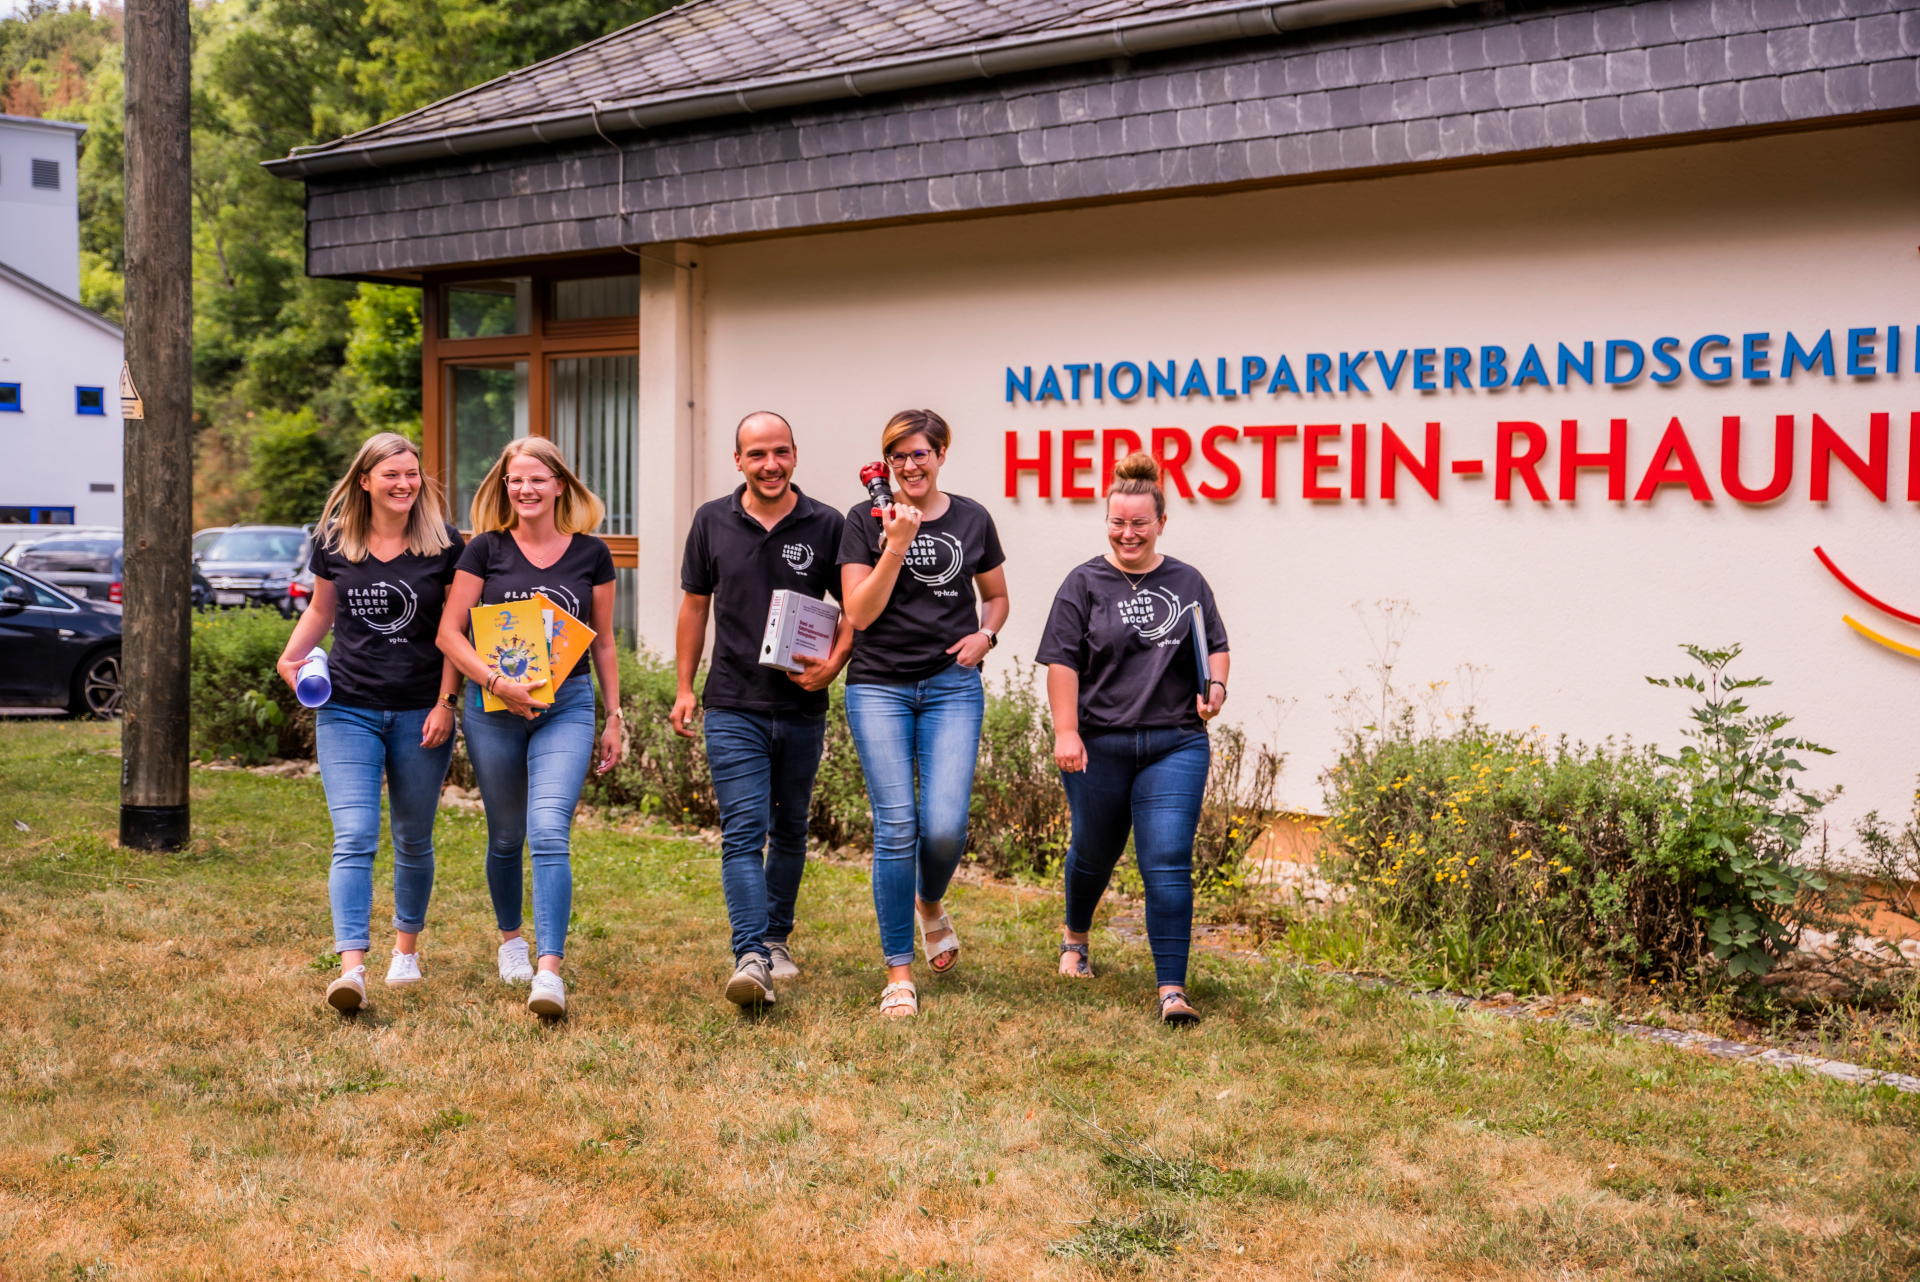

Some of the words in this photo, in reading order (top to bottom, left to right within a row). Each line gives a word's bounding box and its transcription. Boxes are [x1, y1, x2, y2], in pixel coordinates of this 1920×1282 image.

[1005, 325, 1920, 402] NATIONALPARKVERBANDSGEMEI
[1004, 412, 1920, 503] HERRSTEIN-RHAUN
[905, 547, 936, 556] EBEN
[347, 588, 388, 598] #LAND
[933, 589, 959, 597] vg-hr.de
[348, 598, 388, 607] LEBEN
[1117, 597, 1152, 608] #LAND
[351, 607, 389, 616] ROCKT
[1119, 605, 1154, 616] LEBEN
[499, 610, 515, 631] 2
[770, 618, 776, 628] 4
[1122, 613, 1155, 624] ROCKT
